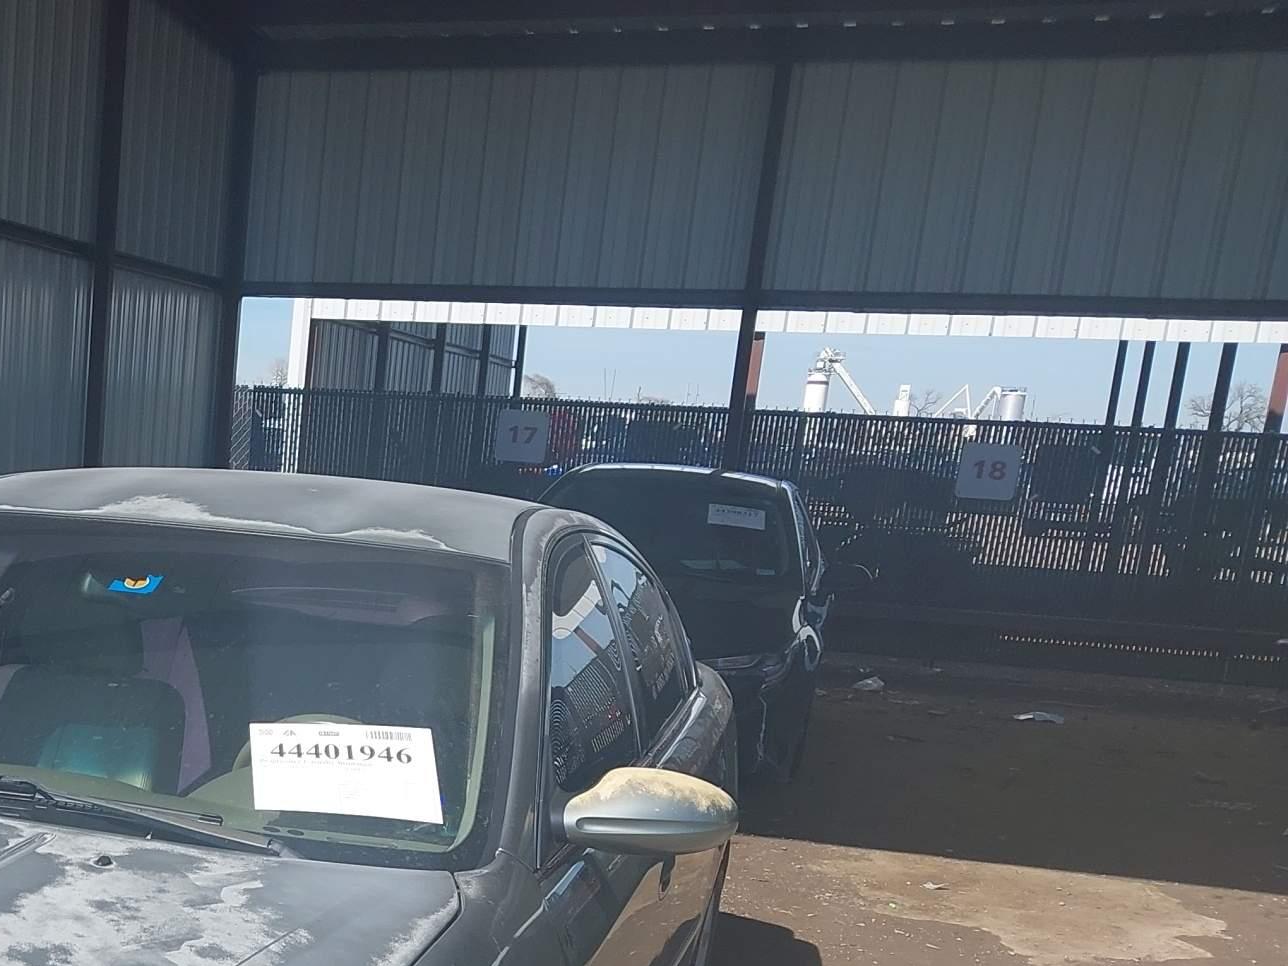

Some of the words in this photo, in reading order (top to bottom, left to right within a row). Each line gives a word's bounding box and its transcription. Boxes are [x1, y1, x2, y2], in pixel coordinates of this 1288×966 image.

[509, 425, 538, 444] 17
[974, 460, 1007, 481] 18
[270, 742, 413, 765] 44401946
